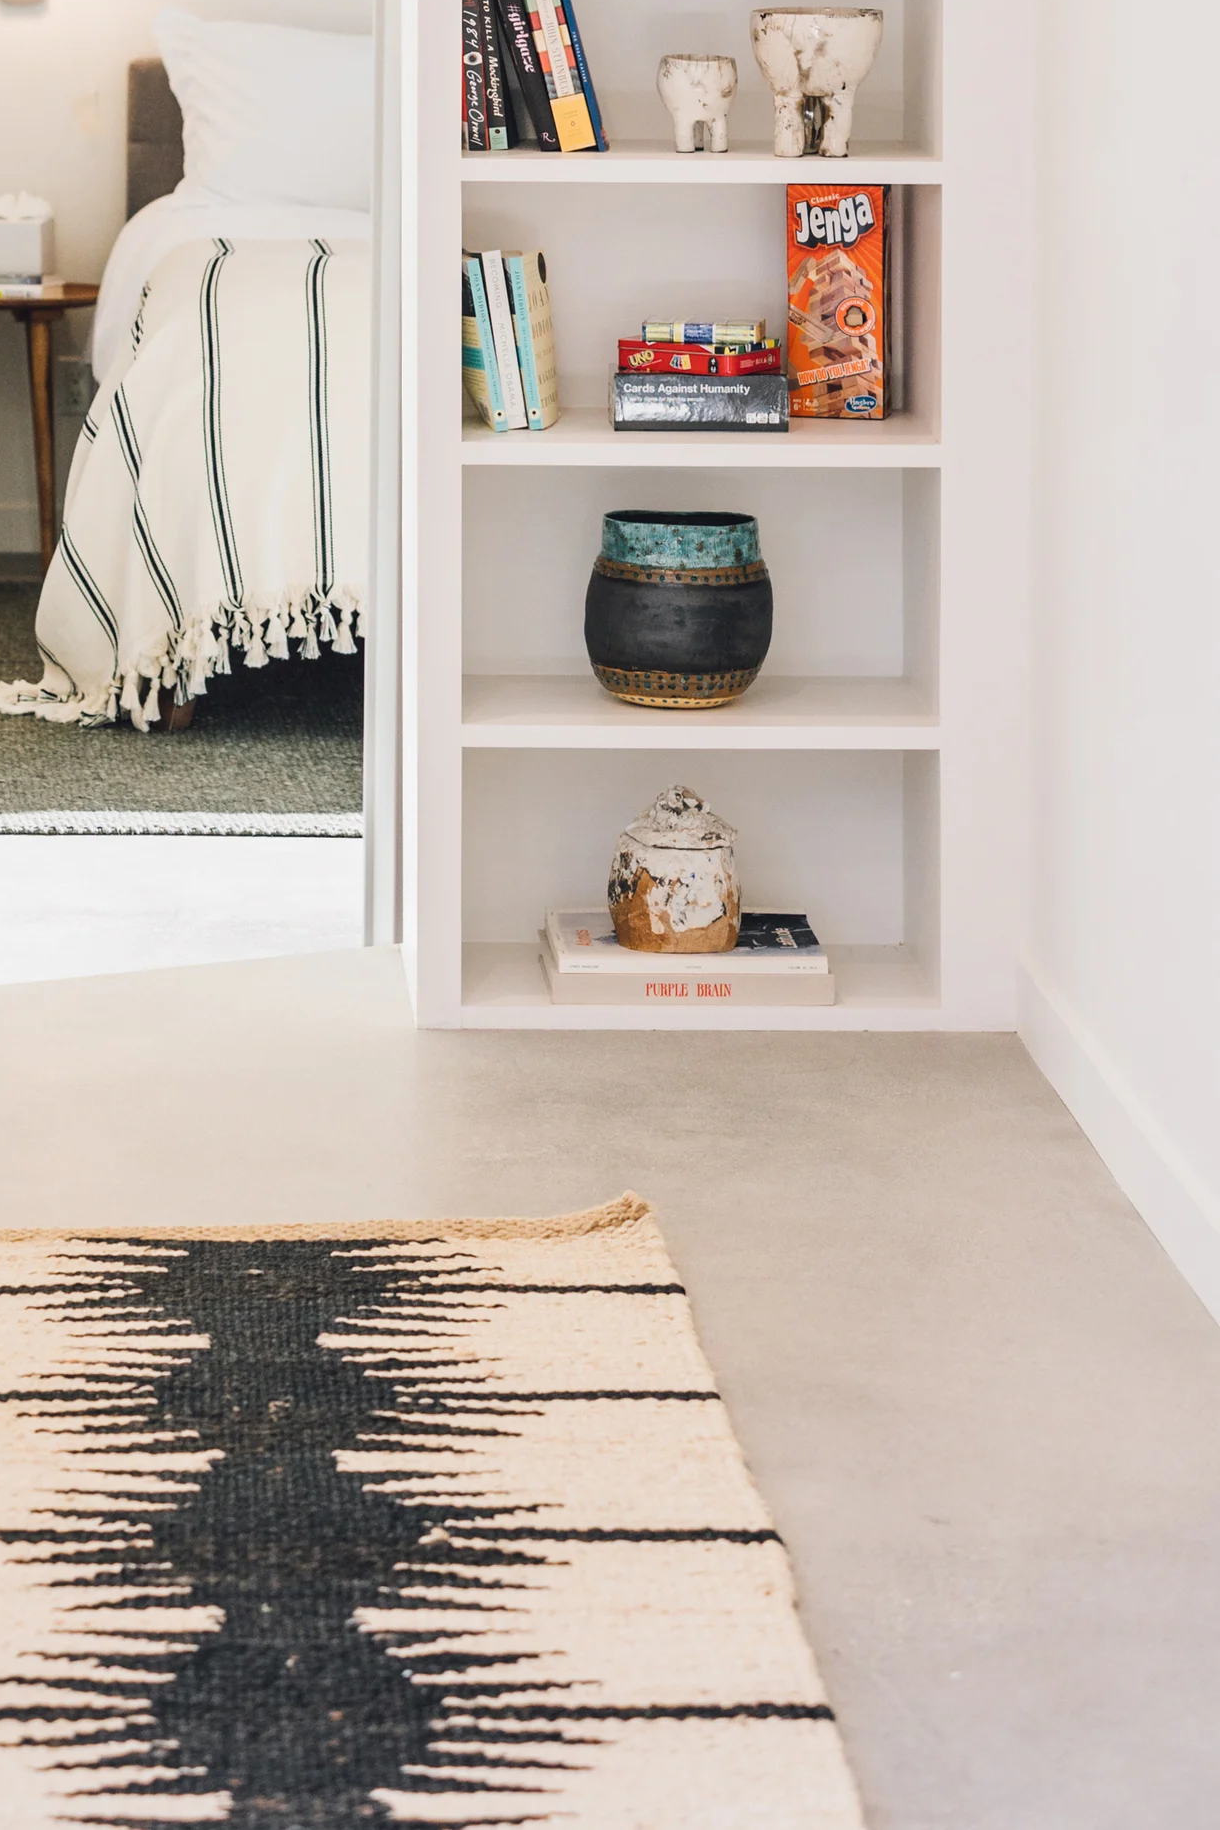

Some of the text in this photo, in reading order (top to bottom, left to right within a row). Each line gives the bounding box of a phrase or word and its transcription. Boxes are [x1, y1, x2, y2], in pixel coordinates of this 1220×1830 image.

[464, 10, 478, 48] 1984
[507, 4, 535, 73] #girlgaze
[482, 0, 504, 118] TO KILL A Mockingbird
[466, 69, 484, 146] George Orwell
[796, 193, 874, 244] Jenga
[810, 193, 840, 204] Classic
[474, 273, 486, 324] JOAN DIDION
[514, 270, 526, 322] JOAN DIDION
[488, 258, 516, 408] BECOMING MICHELLE OBAMA
[628, 350, 655, 368] UNO
[798, 358, 870, 384] HOW DO YOU JENGA?
[623, 383, 750, 396] Cards Against Humanity
[847, 396, 874, 407] Hasbro
[646, 983, 732, 998] PURPLE BRAIN
